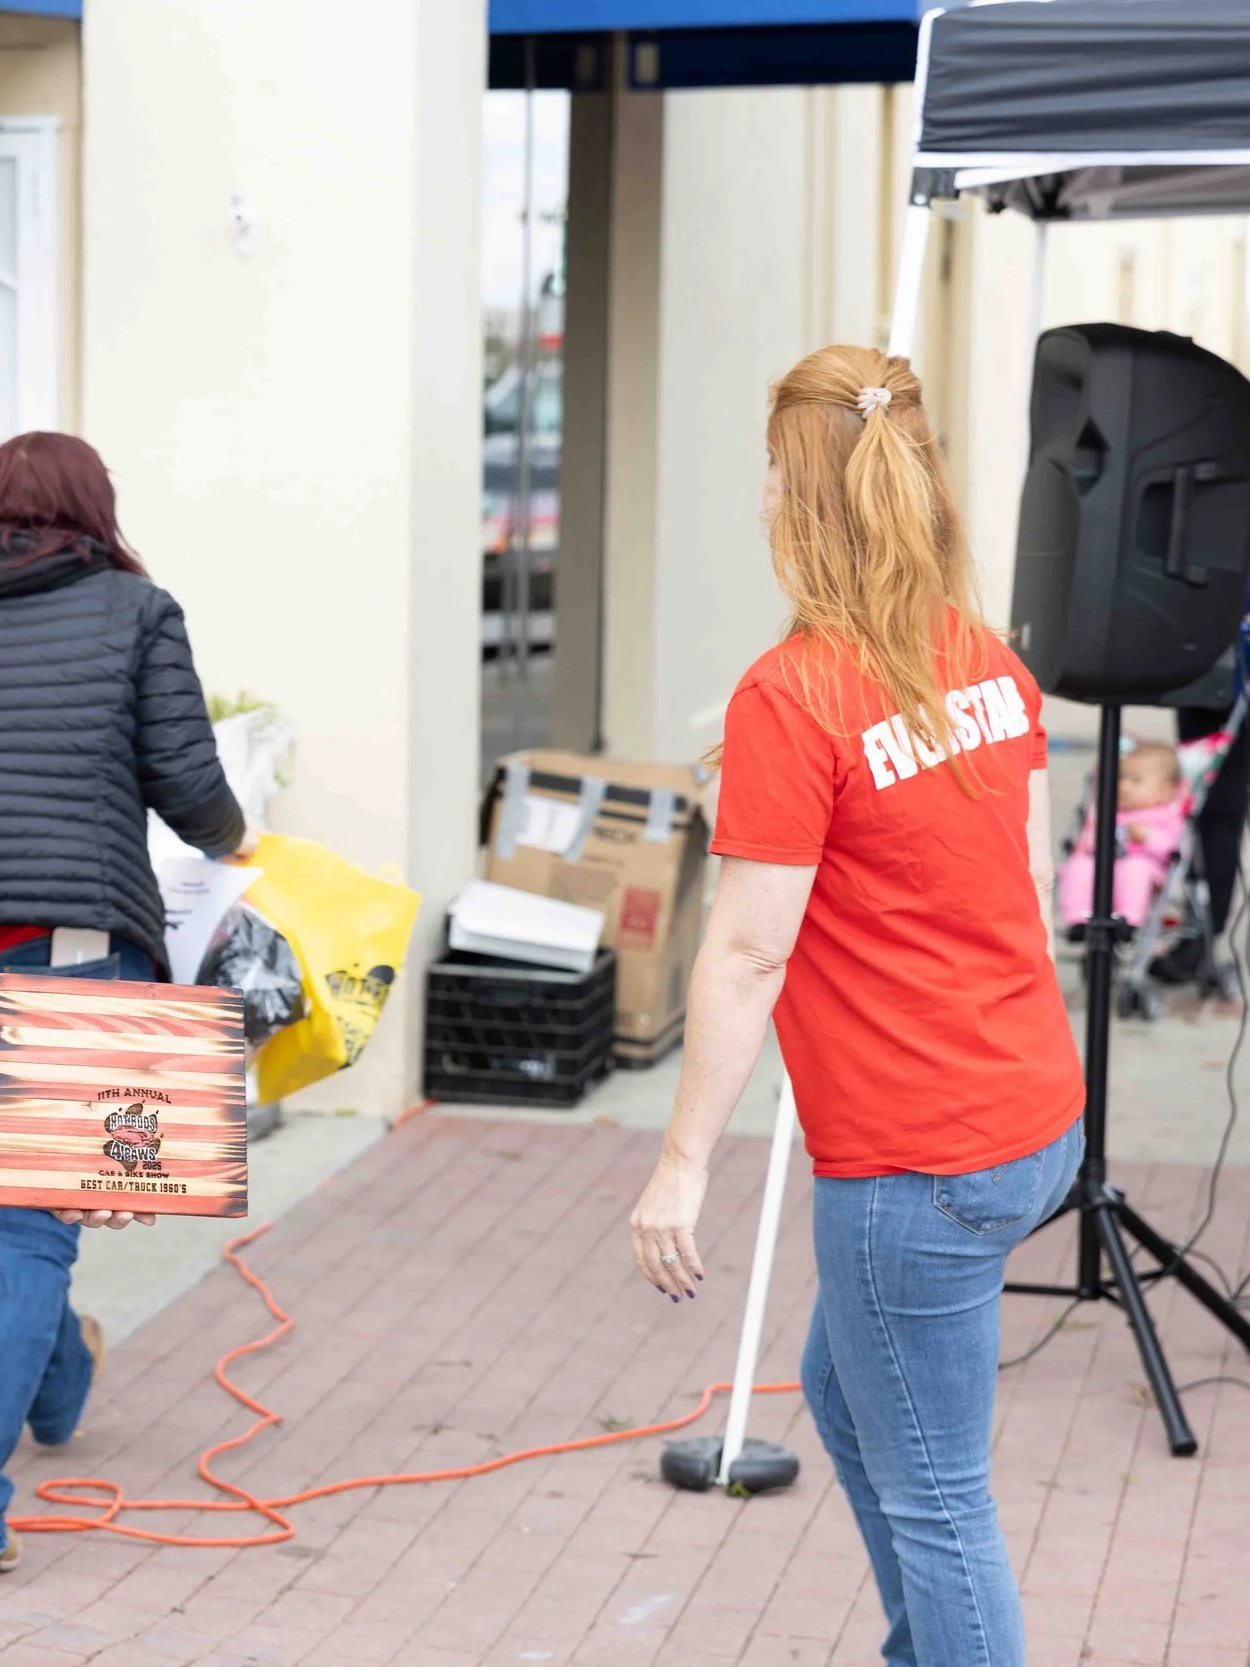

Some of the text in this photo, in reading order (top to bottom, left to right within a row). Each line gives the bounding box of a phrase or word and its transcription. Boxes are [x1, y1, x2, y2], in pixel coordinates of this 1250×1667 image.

[861, 675, 1030, 791] EVSTAR
[97, 1087, 172, 1104] 11TH ANNUAL
[130, 1114, 157, 1133] RODS
[123, 1146, 158, 1162] PAWS
[142, 1161, 162, 1171] 2025
[80, 1179, 187, 1194] BEST CAR/TRUCK 1960'S
